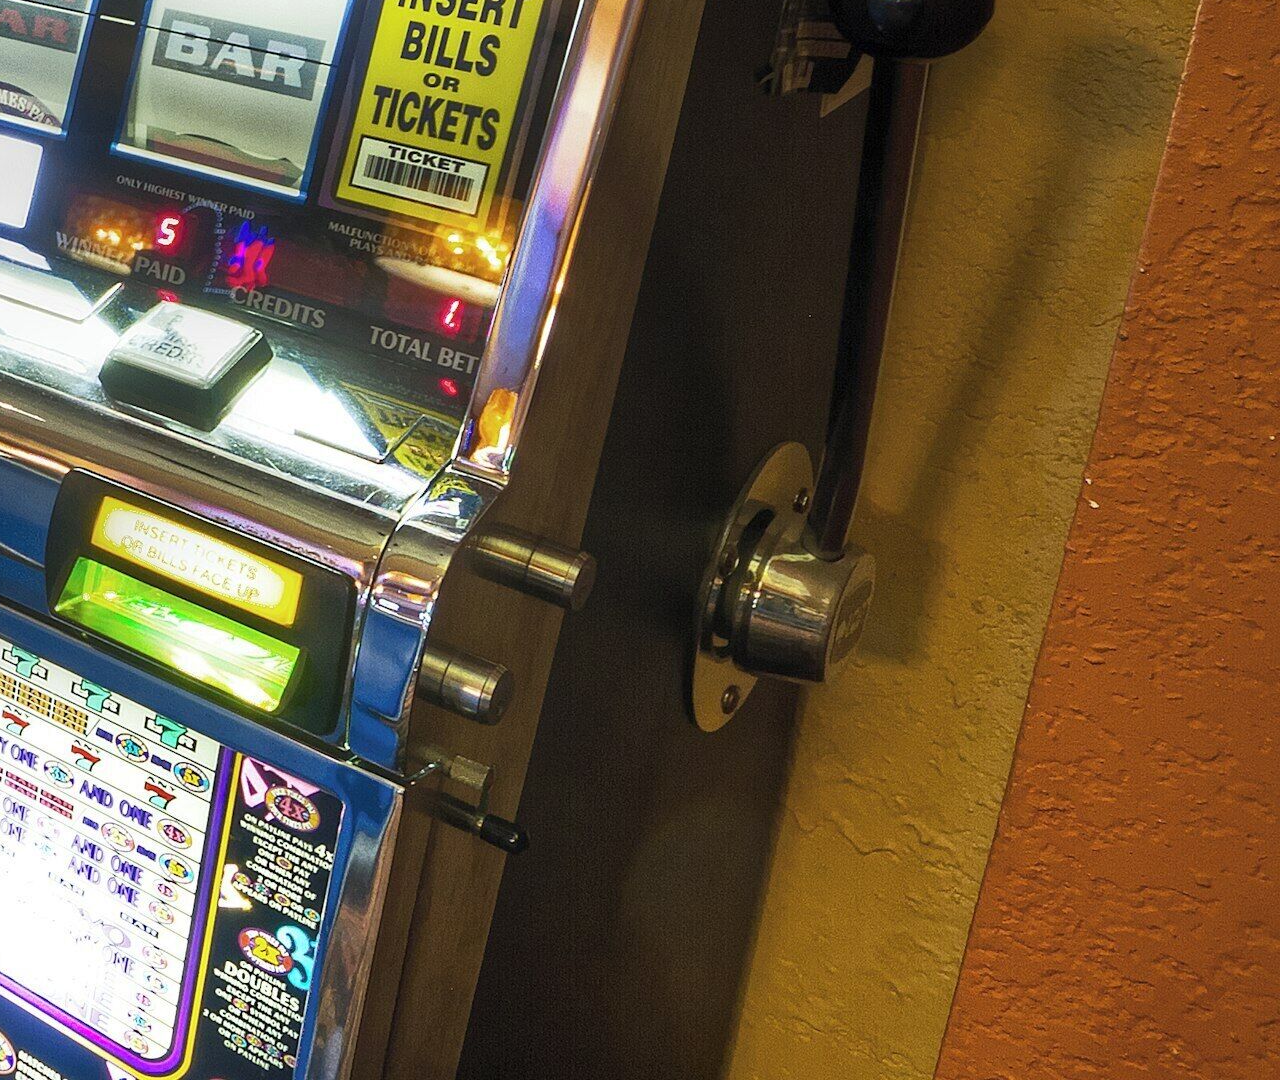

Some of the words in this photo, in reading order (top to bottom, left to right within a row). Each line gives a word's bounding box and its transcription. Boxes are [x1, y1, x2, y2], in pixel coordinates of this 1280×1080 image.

[164, 20, 308, 88] BAR
[400, 20, 502, 77] BILLS
[422, 72, 460, 93] OR
[371, 85, 501, 151] TICKETS
[388, 145, 466, 173] TICKET
[116, 174, 142, 190] ONLY
[143, 181, 186, 202] HIGHEST
[188, 193, 228, 214] WINNER
[228, 204, 256, 220] PAID
[328, 221, 414, 250] MALFUNCTION
[349, 238, 384, 255] PLAYS
[134, 256, 186, 286] PAID
[230, 285, 327, 329] CREDITS
[369, 325, 433, 362] TOTAL
[437, 346, 479, 374] BET
[134, 519, 188, 550] INSERT
[147, 545, 187, 571] BILLS
[237, 583, 260, 601] UP
[224, 961, 300, 1012] DOUBLES
